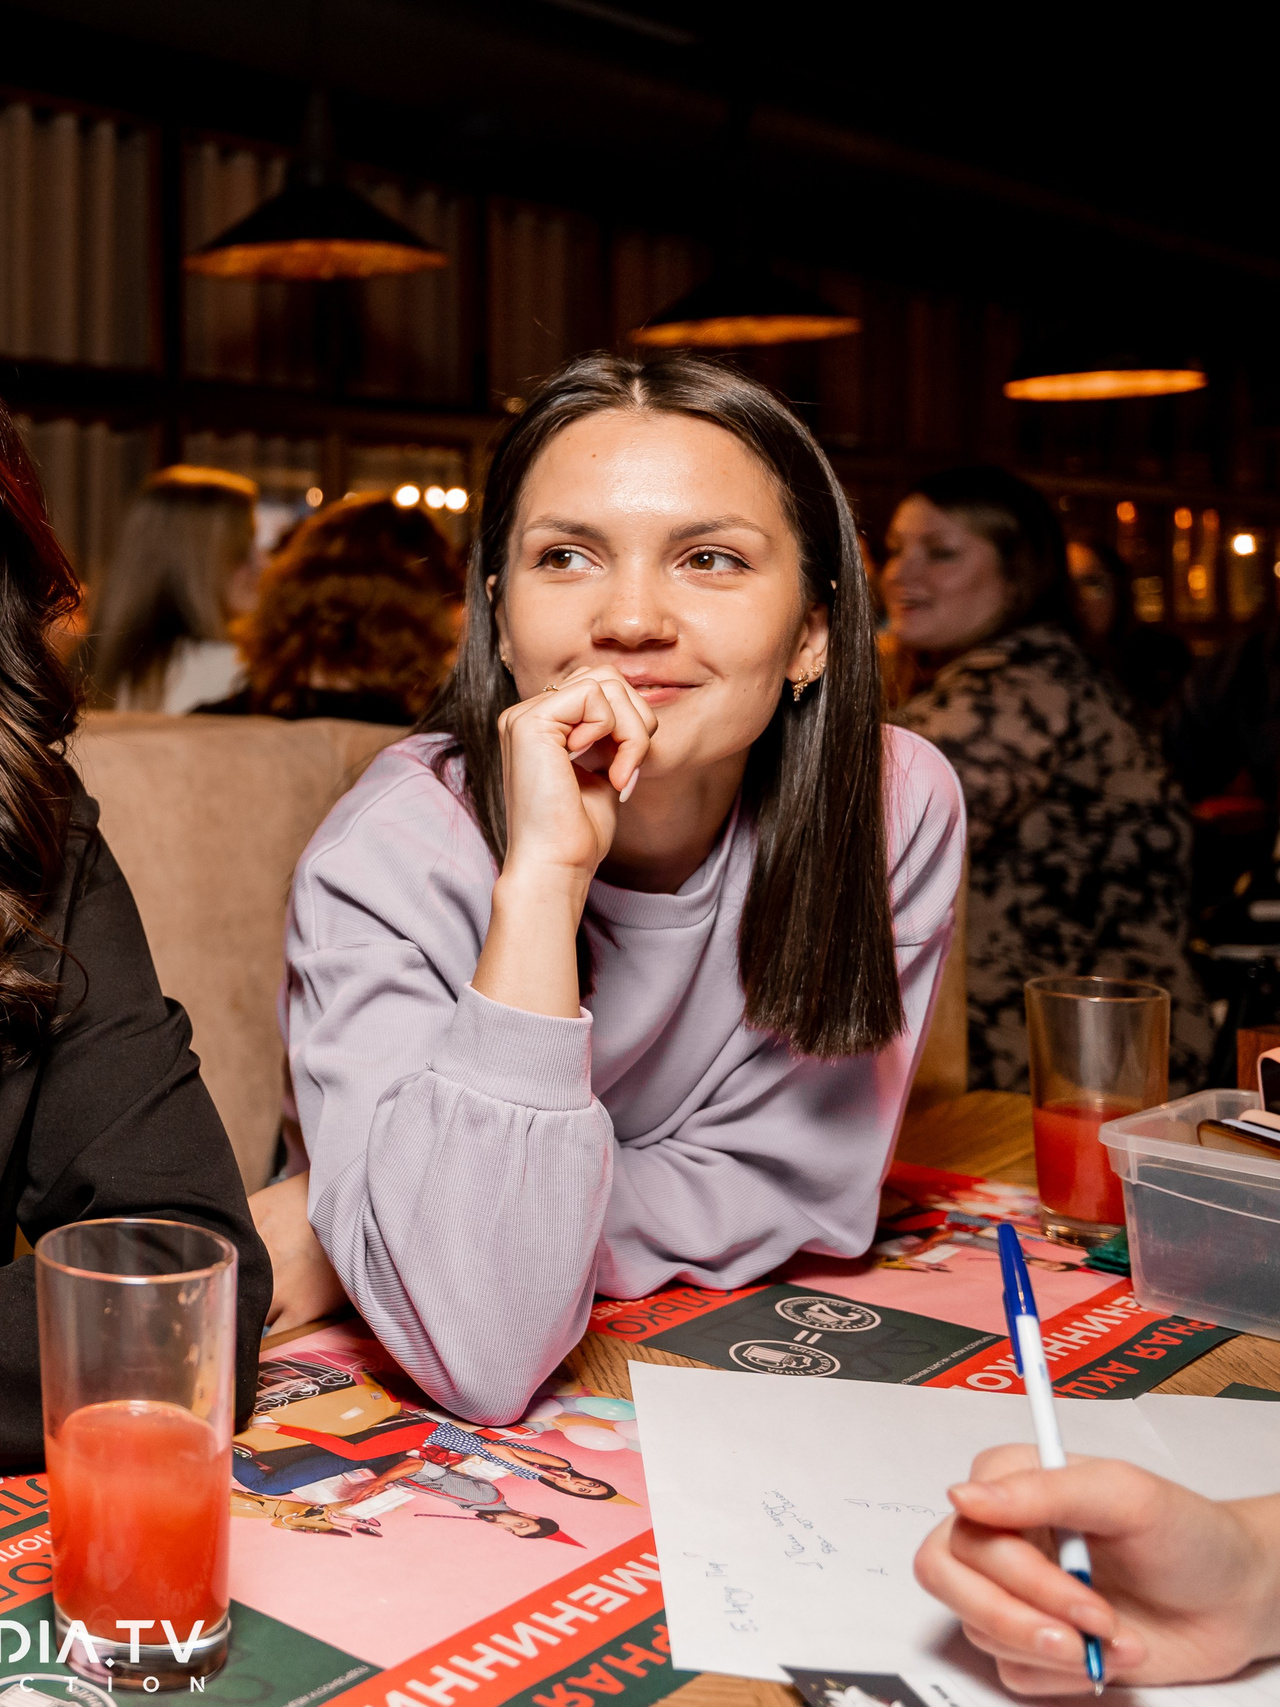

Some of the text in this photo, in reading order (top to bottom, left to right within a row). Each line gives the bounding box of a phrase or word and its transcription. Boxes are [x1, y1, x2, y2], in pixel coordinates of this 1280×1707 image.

[606, 1288, 732, 1334] ОЛЬКО
[948, 1291, 1149, 1391] ЕНИННКО
[1052, 1359, 1140, 1399] АКЦ
[531, 1623, 671, 1707] РНАЯ
